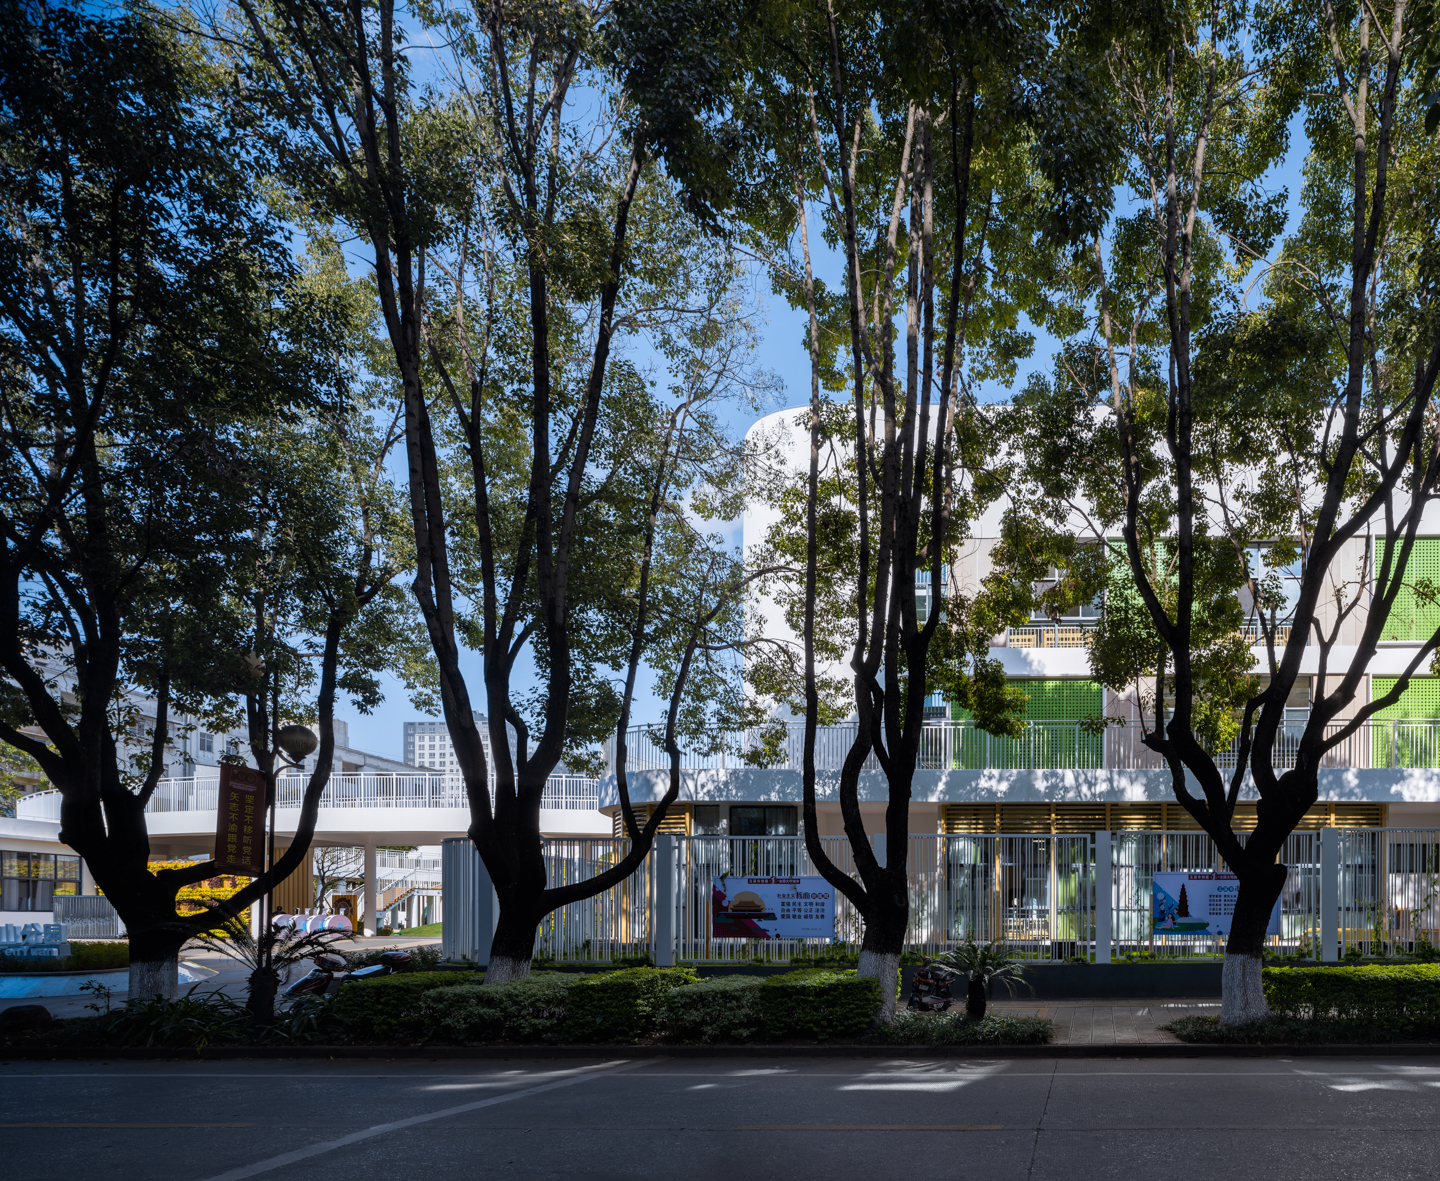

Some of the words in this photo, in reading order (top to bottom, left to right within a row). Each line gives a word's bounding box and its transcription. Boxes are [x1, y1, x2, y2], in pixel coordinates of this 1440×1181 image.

[226, 791, 240, 864] 矢志不渝跟党走
[242, 794, 255, 866] 坚定不移听党话
